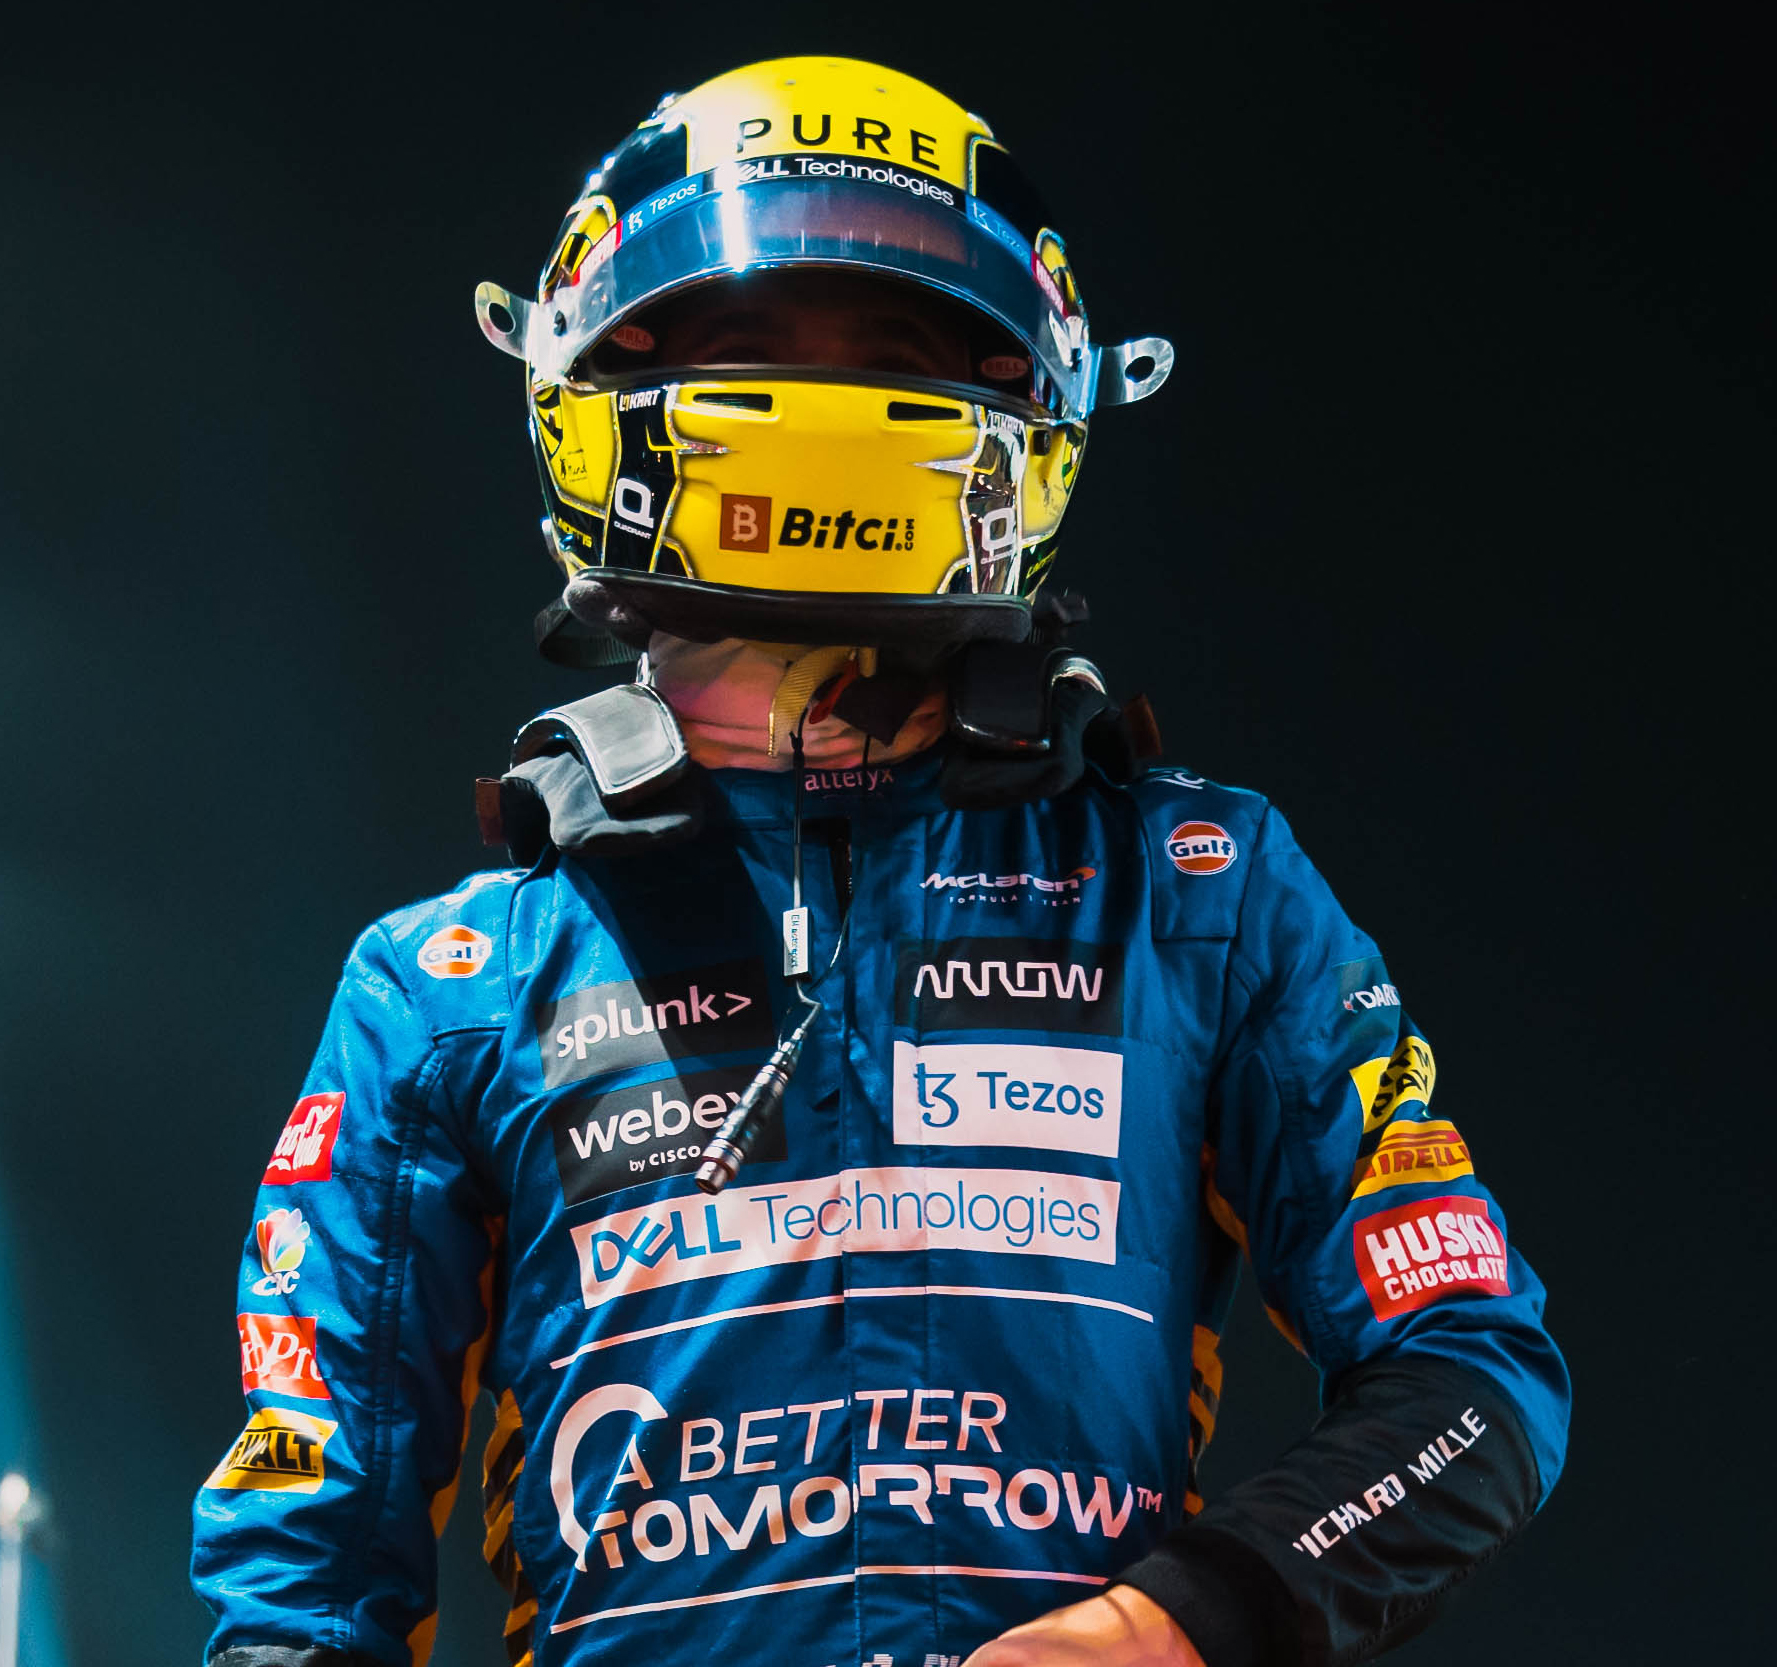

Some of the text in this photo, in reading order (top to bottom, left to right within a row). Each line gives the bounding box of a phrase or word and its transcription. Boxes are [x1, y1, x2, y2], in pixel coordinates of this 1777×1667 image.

[736, 113, 940, 171] PURE
[649, 182, 698, 215] Tezos
[794, 157, 954, 206] Technologies
[613, 519, 652, 540] QUADRANT
[1168, 840, 1232, 858] Gulf
[919, 872, 1080, 893] McLaren
[978, 1071, 1106, 1120] Tezos
[628, 1144, 702, 1172] by CISCO
[588, 1179, 1102, 1285] DELL Technologies
[1365, 1211, 1502, 1278] HUSKI
[1383, 1256, 1506, 1301] CHOCOLATE
[679, 1388, 1008, 1483] BETTER
[1291, 1406, 1487, 1560] ICHARD MILLE
[588, 1463, 1133, 1571] TOMORROW
